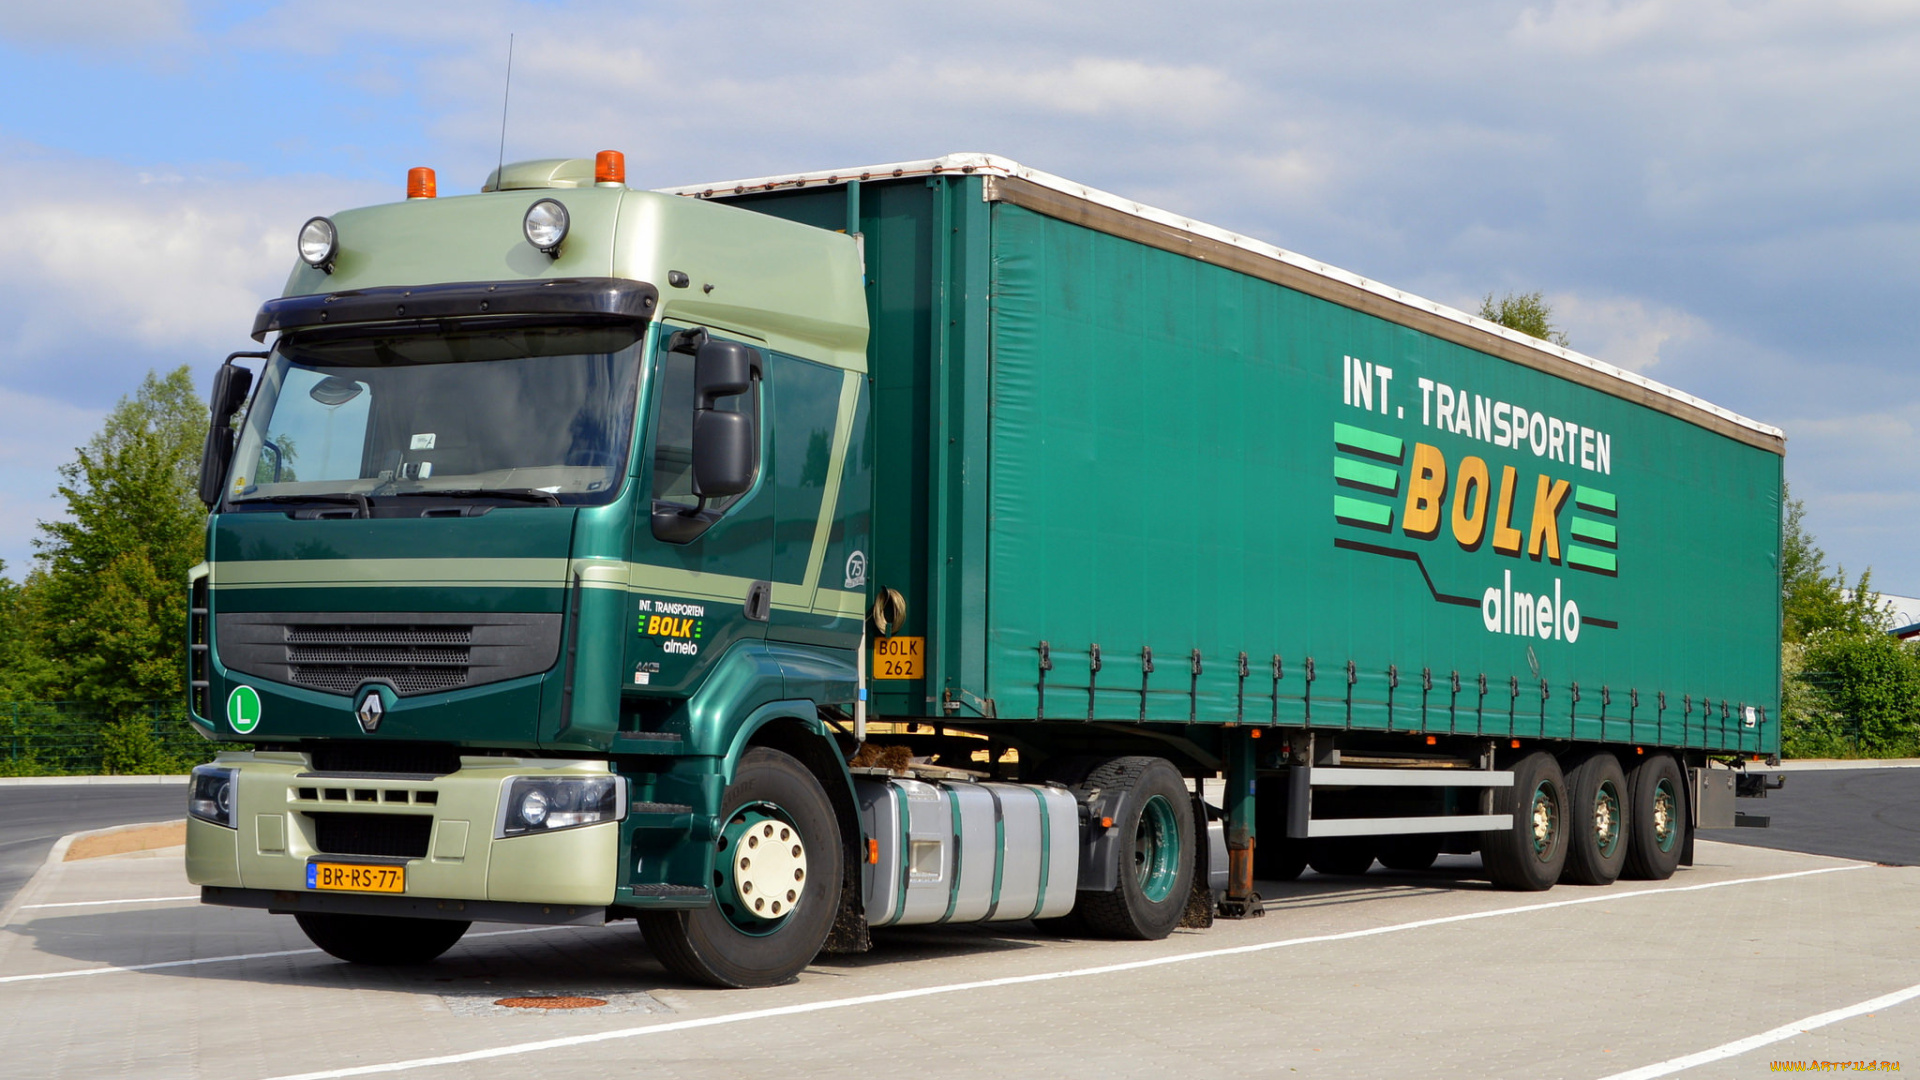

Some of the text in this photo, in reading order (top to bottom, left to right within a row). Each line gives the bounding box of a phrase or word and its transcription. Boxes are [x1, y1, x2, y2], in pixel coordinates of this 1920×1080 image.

[1343, 355, 1611, 475] INT. TRANSPORTEN
[1402, 442, 1571, 564] BOLK
[851, 560, 863, 577] 75
[638, 599, 704, 617] INT. TRANSPORTEN
[1482, 569, 1580, 643] almelo
[647, 615, 694, 638] BOLK
[663, 638, 698, 656] almelo
[879, 640, 918, 655] BOLK
[884, 660, 913, 676] 262
[236, 695, 251, 725] L
[323, 867, 398, 889] BR-RS-77
